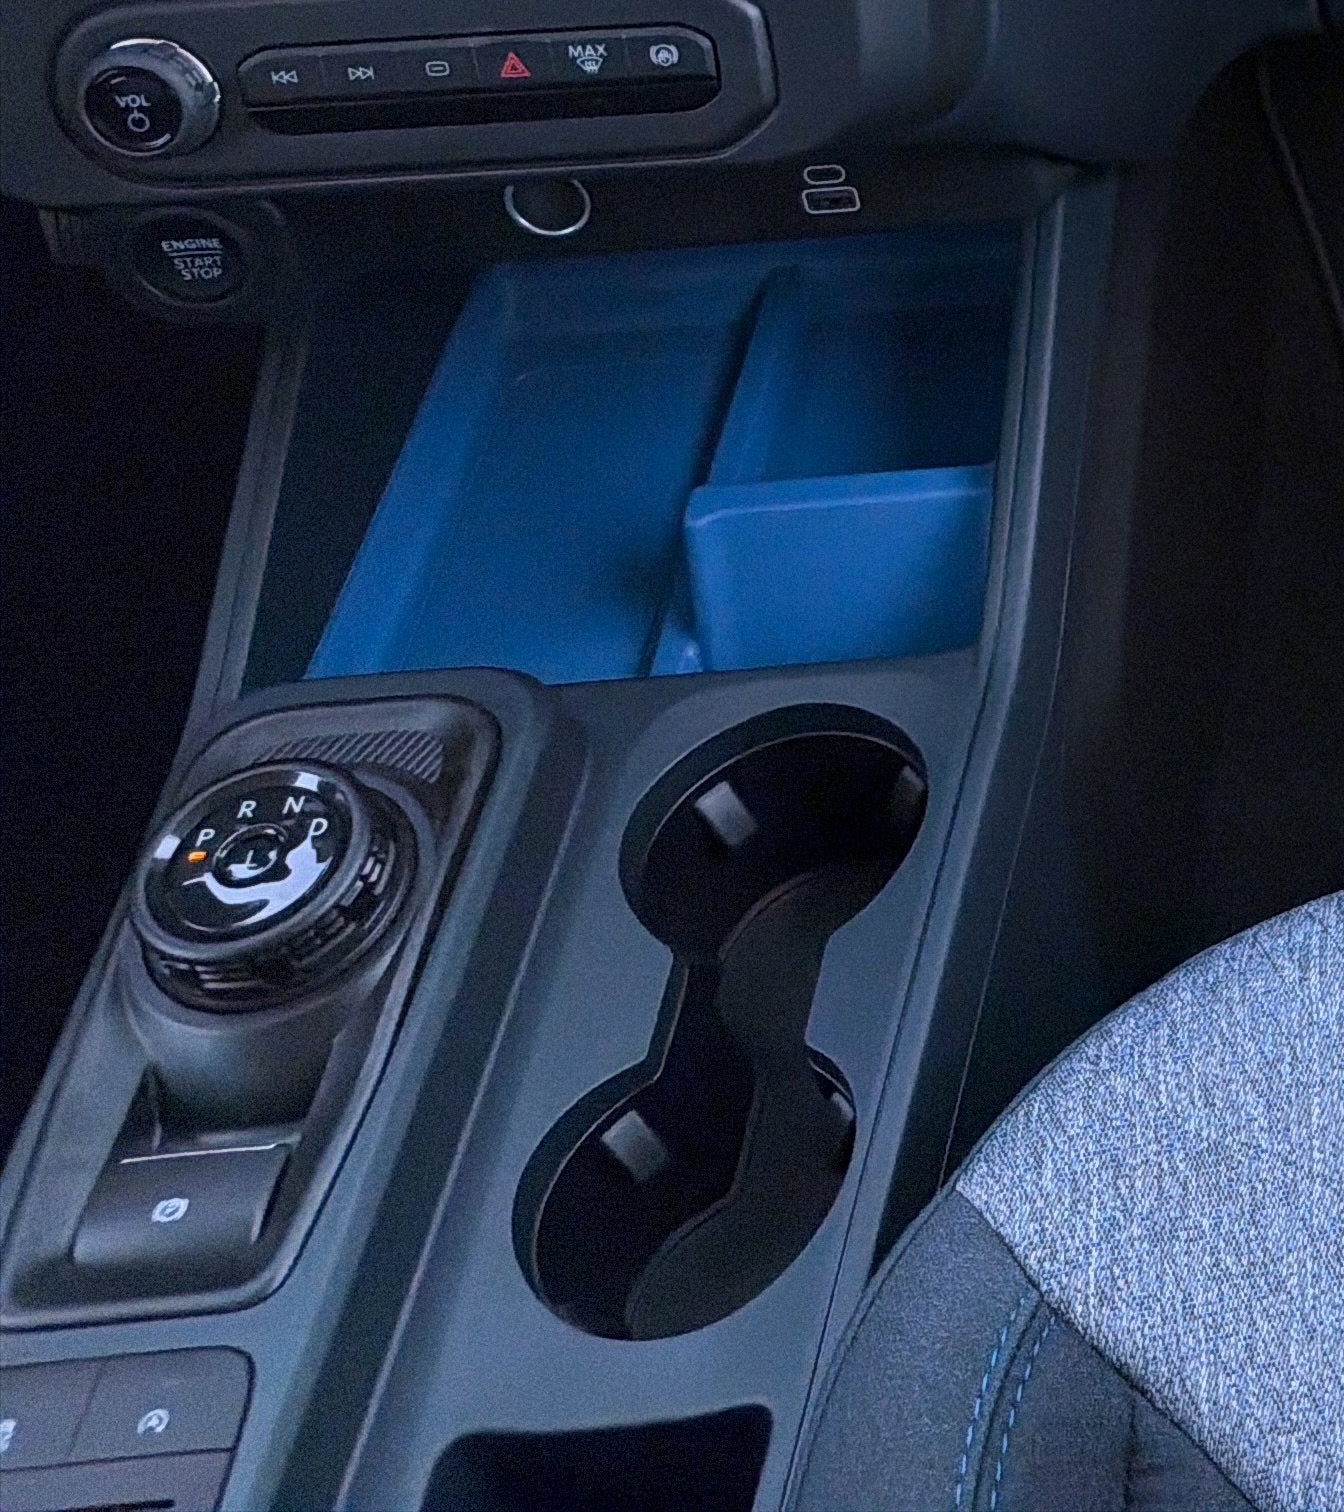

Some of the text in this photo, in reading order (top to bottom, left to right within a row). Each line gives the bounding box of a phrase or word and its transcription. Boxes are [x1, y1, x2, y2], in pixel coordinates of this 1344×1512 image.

[568, 43, 608, 58] MAX
[115, 94, 151, 108] VOL
[161, 239, 223, 252] ENGINE
[173, 256, 222, 270] START
[181, 268, 222, 281] STOP
[195, 828, 216, 847] P
[236, 800, 257, 819] R
[282, 795, 306, 815] N
